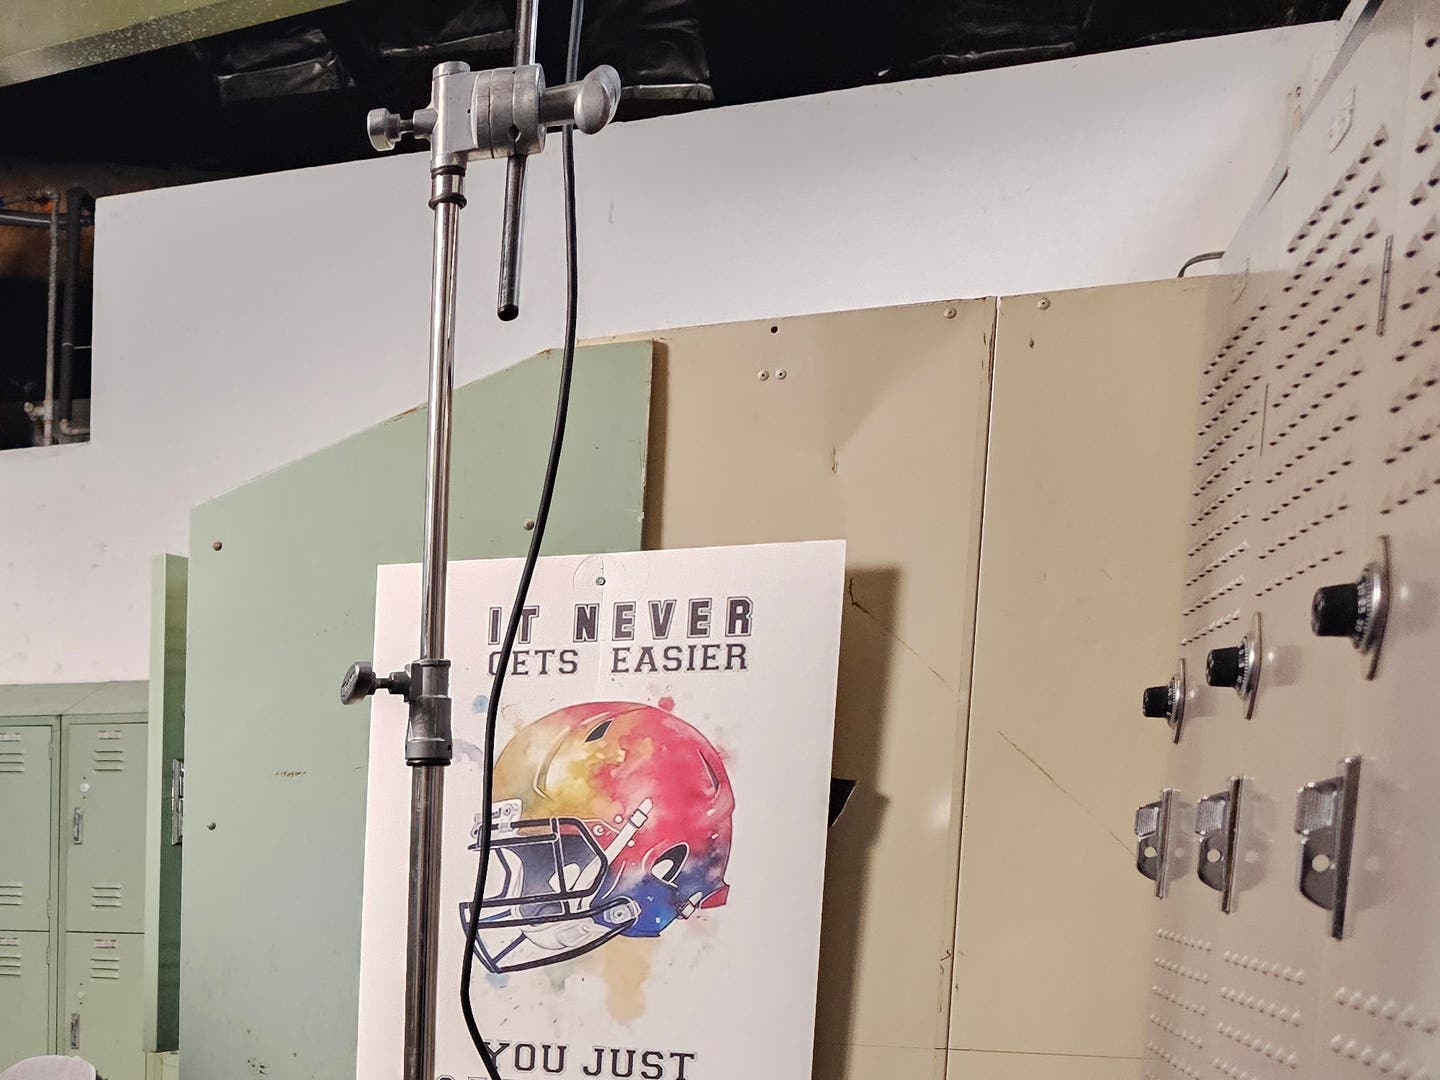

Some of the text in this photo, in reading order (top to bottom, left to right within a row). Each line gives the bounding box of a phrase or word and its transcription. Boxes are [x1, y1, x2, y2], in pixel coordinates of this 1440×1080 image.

[488, 596, 754, 646] IT NEVER
[610, 643, 748, 674] EASIER
[483, 1041, 568, 1074] YOU
